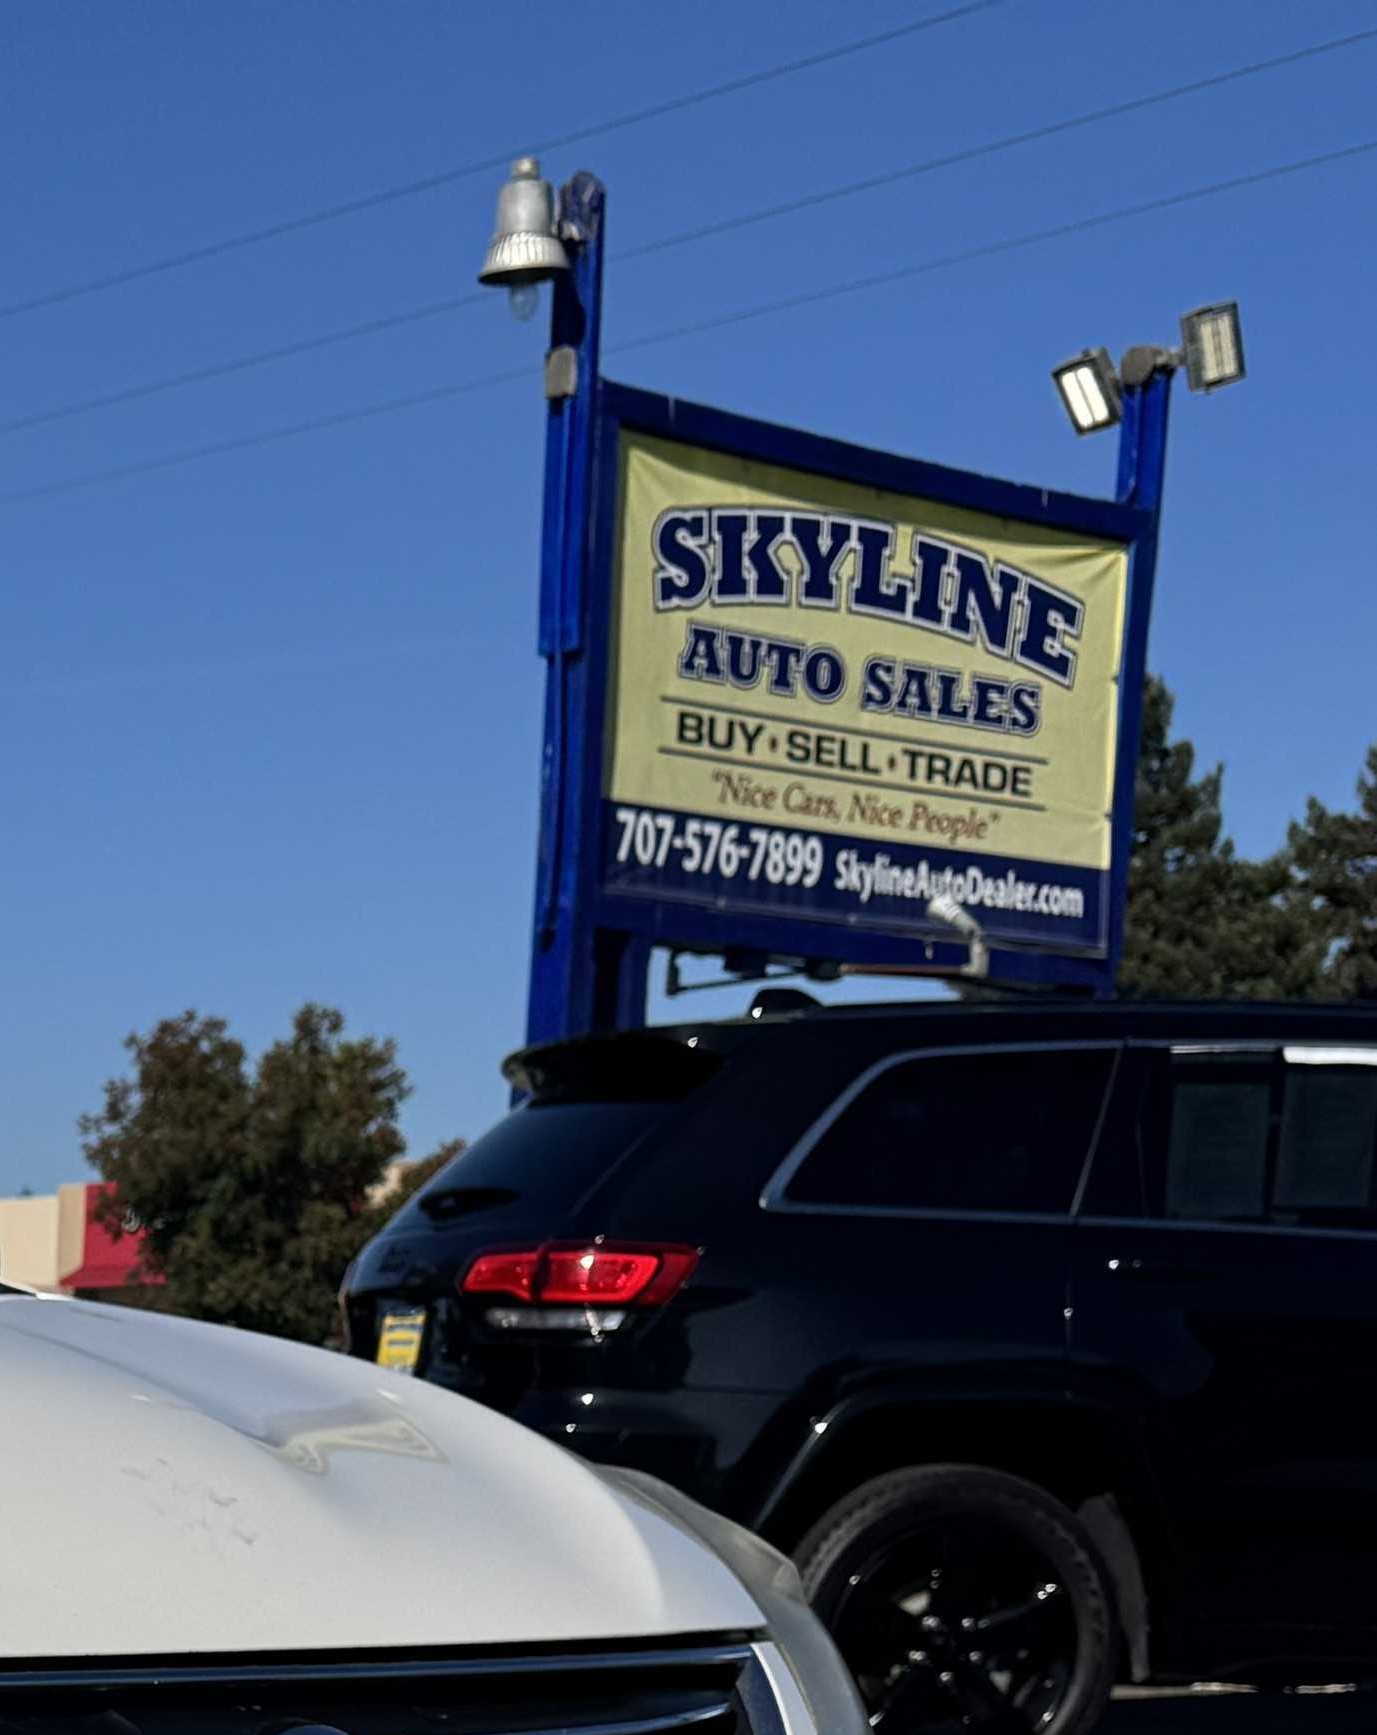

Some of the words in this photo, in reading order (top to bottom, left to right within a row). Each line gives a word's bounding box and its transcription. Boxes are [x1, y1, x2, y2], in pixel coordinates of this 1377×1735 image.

[653, 507, 1085, 689] SKYLINE
[679, 620, 846, 703] AUTO
[860, 656, 1042, 737] SALES
[677, 713, 762, 754] BUY
[786, 730, 881, 775] SELL
[902, 749, 1032, 797] TRADE
[782, 783, 841, 820] Cars,
[848, 793, 900, 829] Nice
[616, 809, 823, 888] 707-576-7899
[834, 849, 1084, 918] SkylineAutoDealer.com
